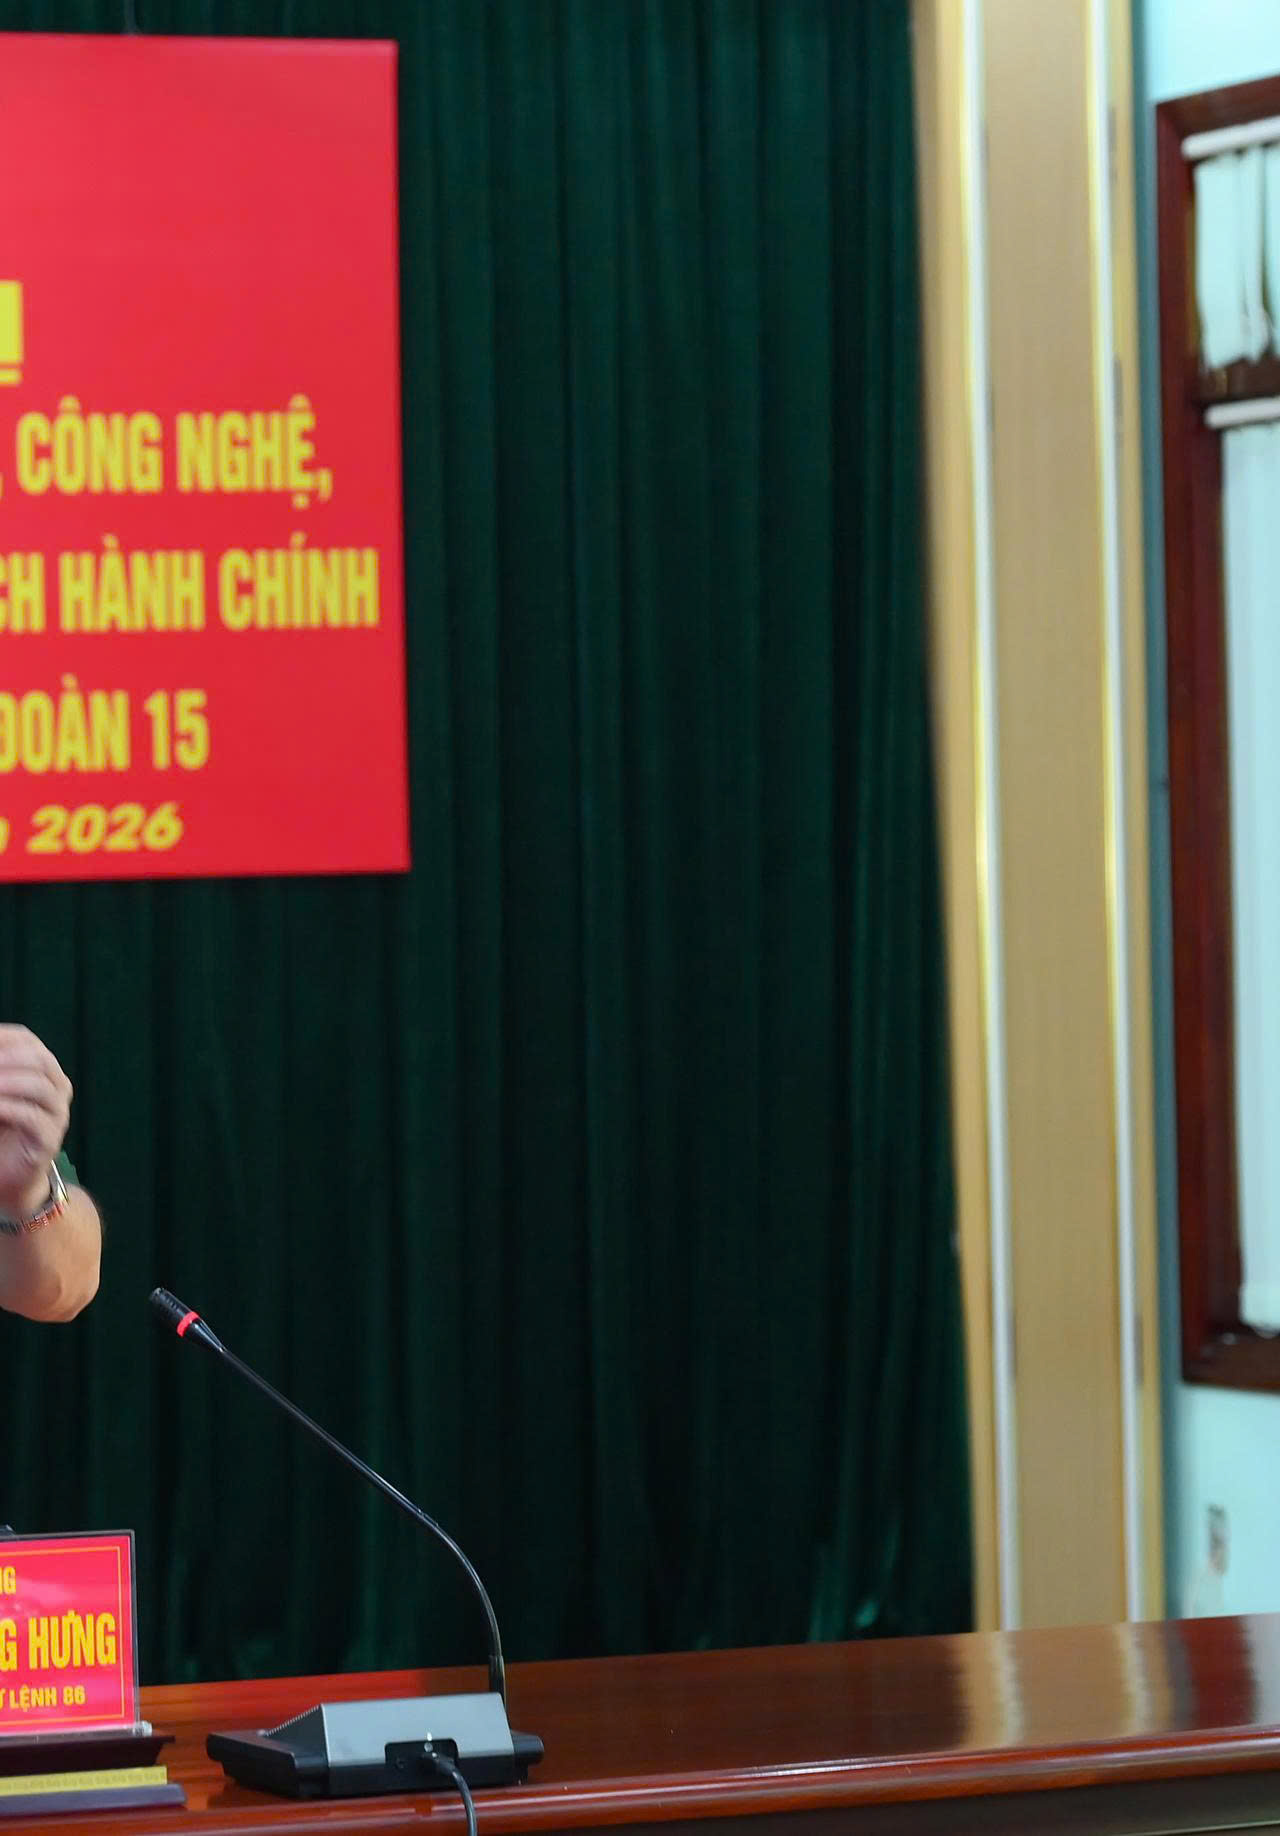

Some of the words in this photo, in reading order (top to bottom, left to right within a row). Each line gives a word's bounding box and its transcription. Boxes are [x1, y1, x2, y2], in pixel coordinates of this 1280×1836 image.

[15, 395, 163, 496] CÔNG
[176, 395, 333, 508] NGHỆ,
[59, 534, 205, 633] HÀNH
[219, 532, 380, 630] CHÍNH
[145, 690, 209, 770] 15
[27, 803, 183, 853] 2026
[28, 1610, 118, 1670] HƯNG
[9, 1684, 58, 1713] LỆNH
